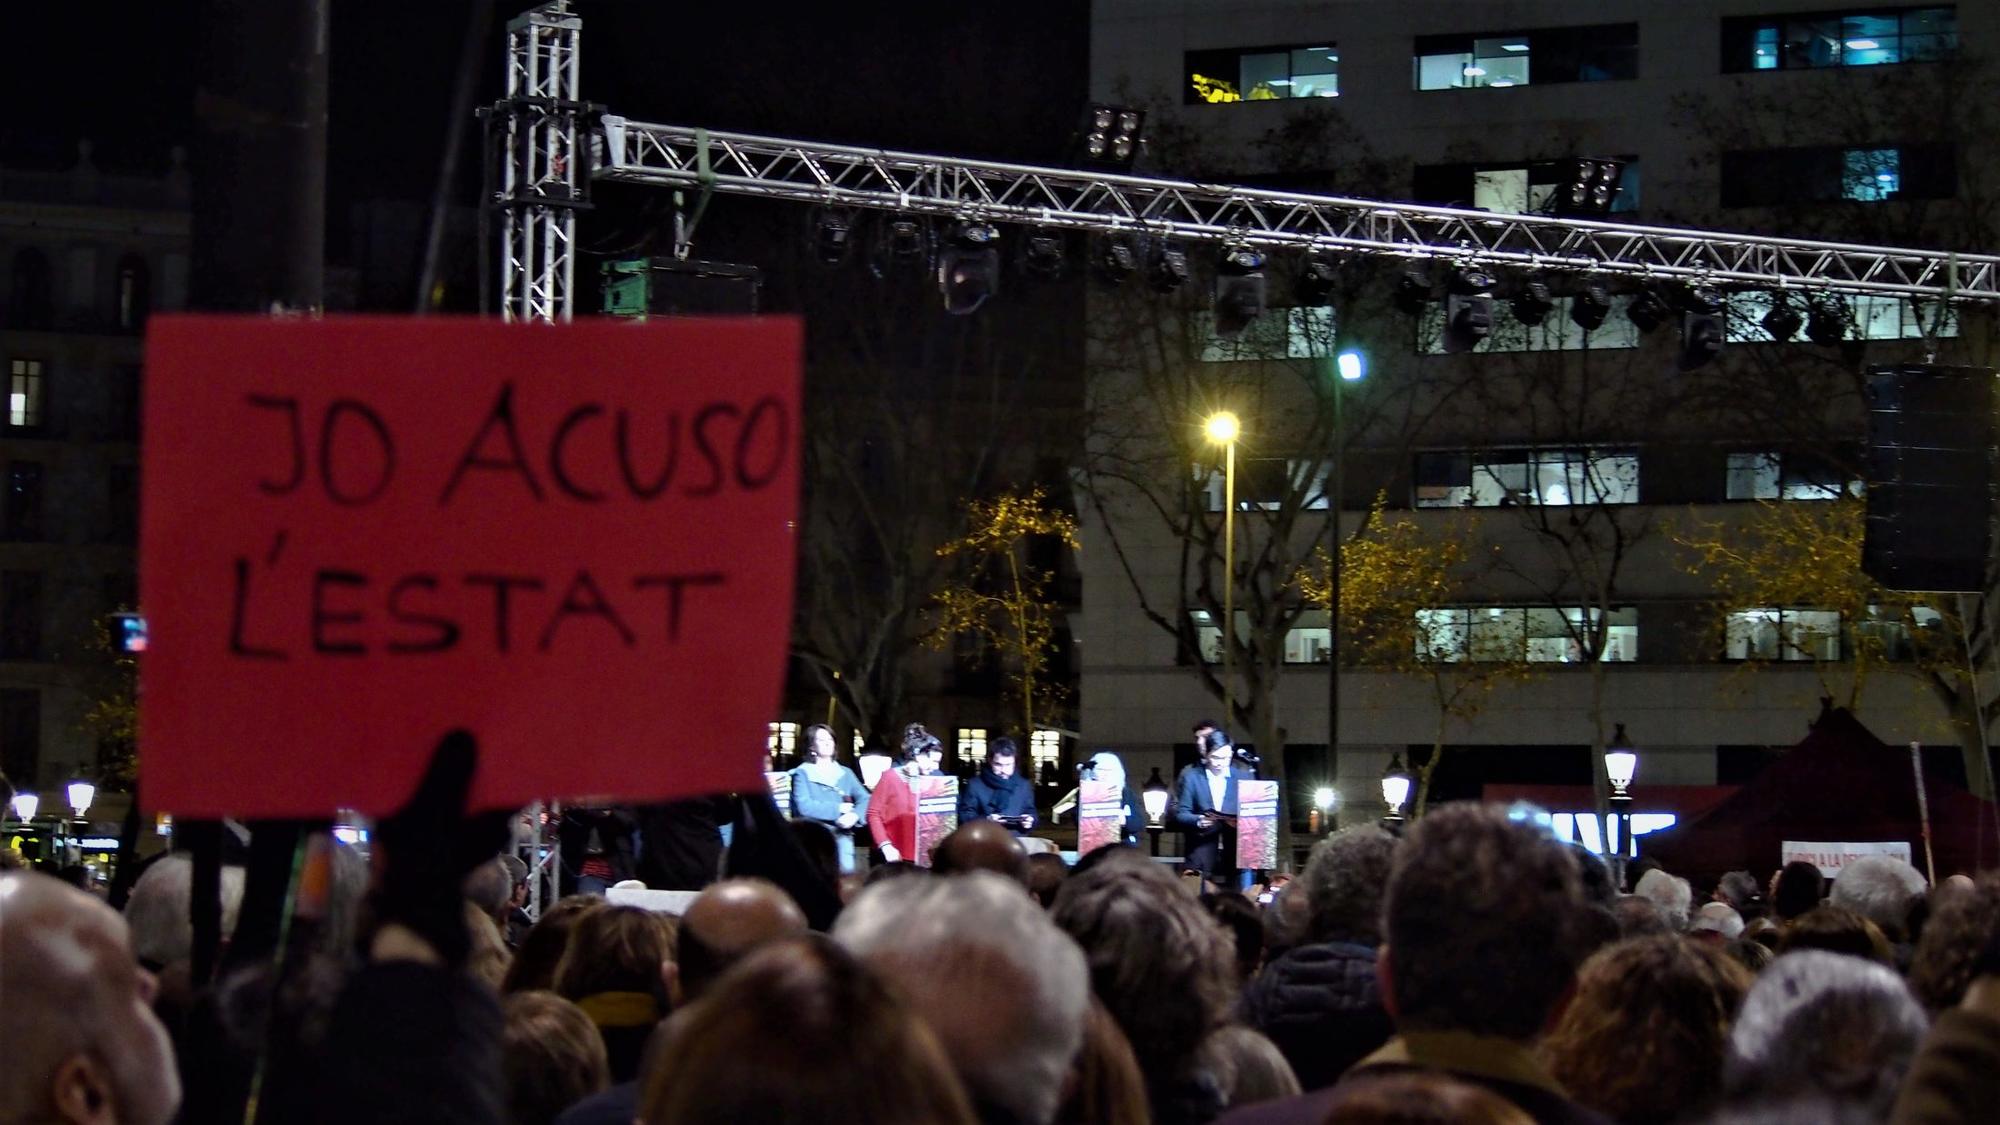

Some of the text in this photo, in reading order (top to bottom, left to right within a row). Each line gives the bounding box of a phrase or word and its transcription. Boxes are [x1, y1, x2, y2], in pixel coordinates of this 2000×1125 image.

[246, 380, 790, 508] JO ACUSO
[227, 530, 726, 661] L'ESTAT
